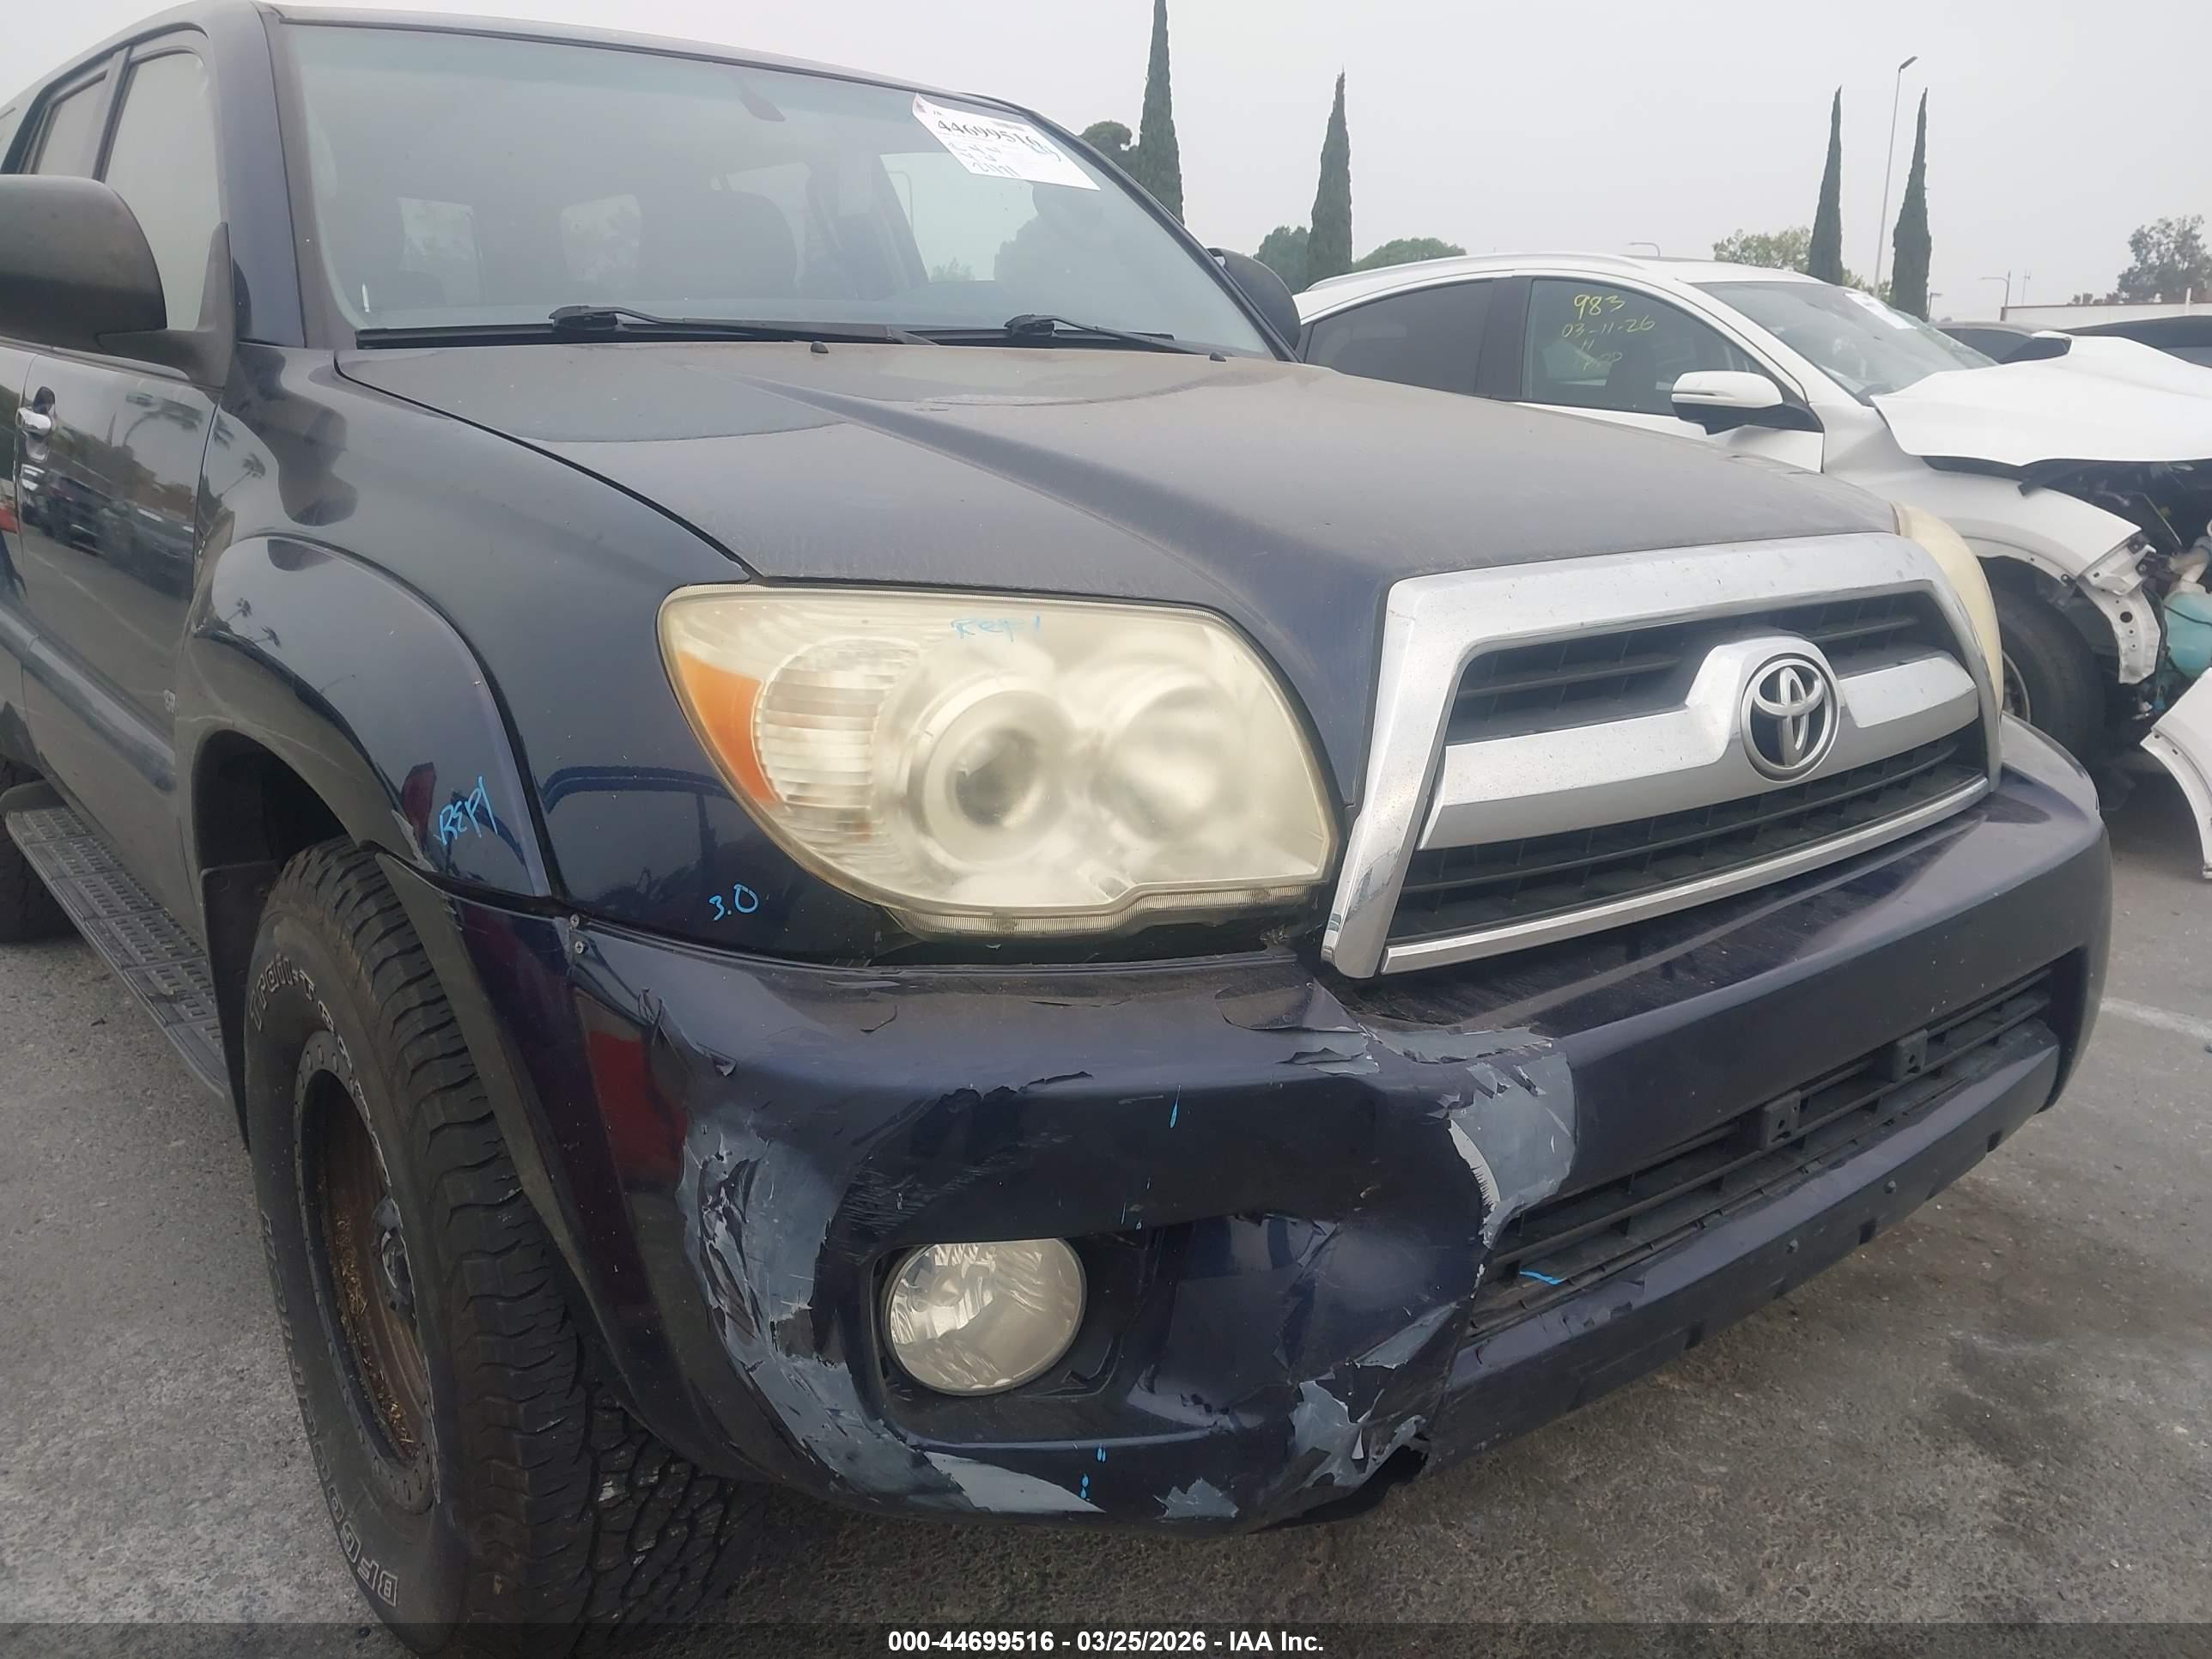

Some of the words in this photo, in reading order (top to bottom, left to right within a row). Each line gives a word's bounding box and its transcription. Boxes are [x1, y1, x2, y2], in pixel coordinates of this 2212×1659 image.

[1574, 294, 1626, 319] 983
[1561, 314, 1656, 337] 03-11-26
[708, 884, 759, 921] 3.0
